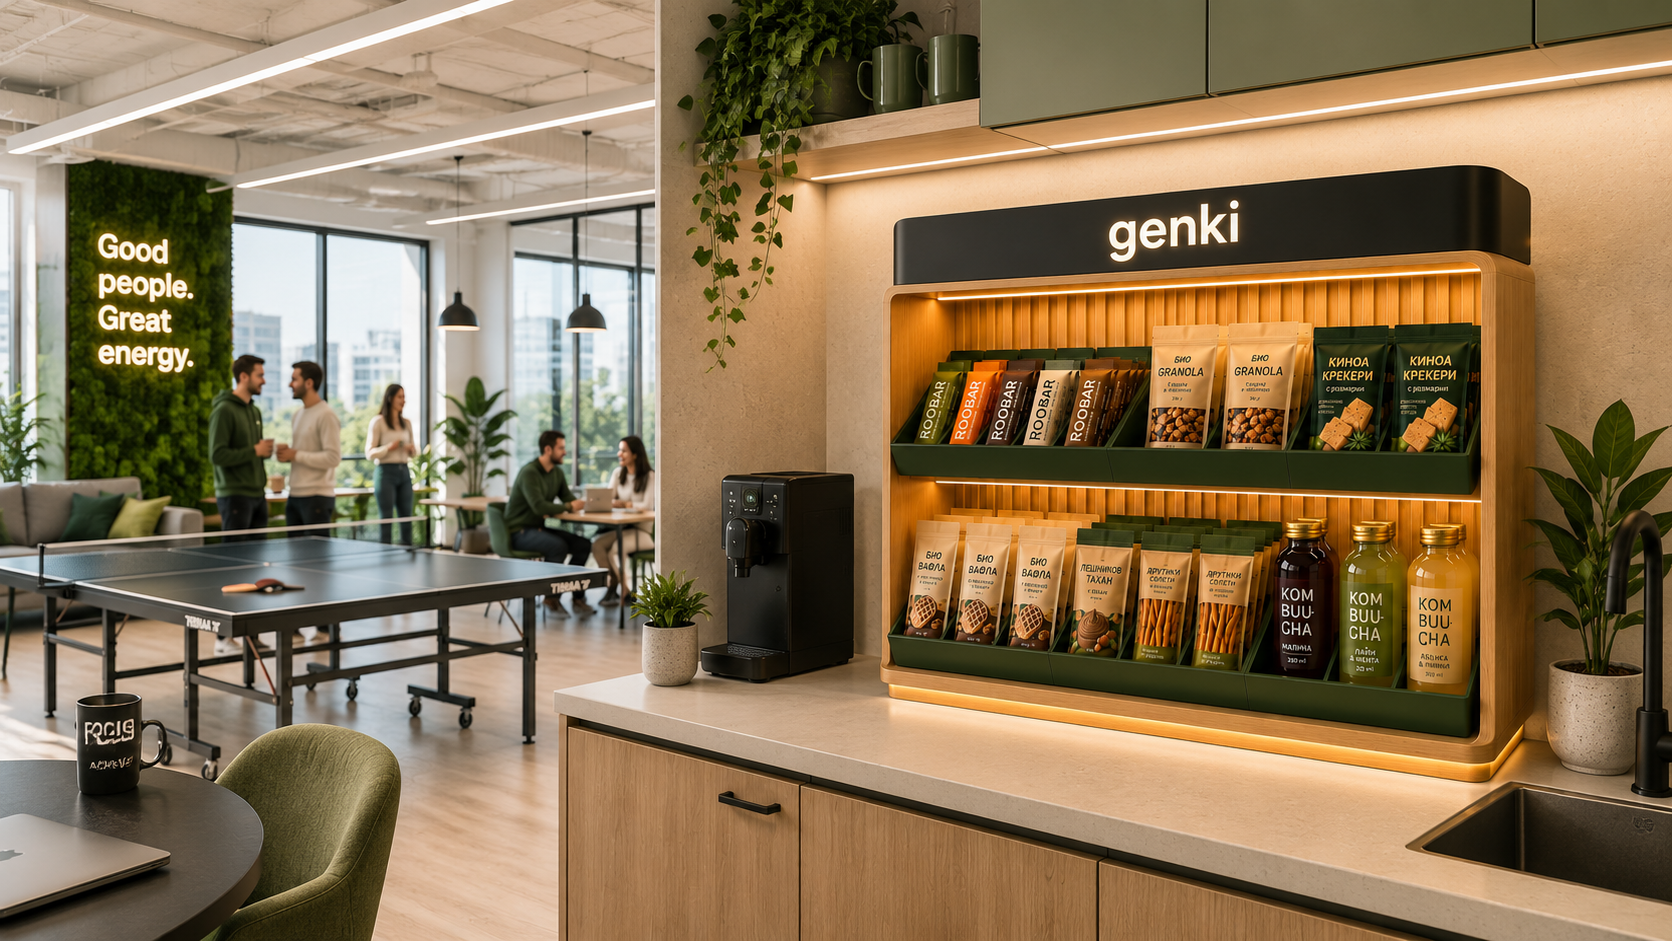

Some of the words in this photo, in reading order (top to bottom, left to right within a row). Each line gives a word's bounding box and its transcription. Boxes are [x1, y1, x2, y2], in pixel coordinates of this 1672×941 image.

[1109, 200, 1239, 262] genki
[98, 233, 168, 264] Good
[98, 273, 194, 302] people.
[98, 305, 172, 333] Great
[98, 344, 194, 373] energy.
[1328, 357, 1369, 368] КИНОА
[1409, 355, 1452, 366] КИНОА
[1158, 367, 1204, 377] GRANOLA
[1234, 366, 1283, 376] GRANOLA
[1322, 370, 1374, 381] КРЕКЕРИ
[1403, 369, 1457, 381] КРЕКЕРИ
[920, 380, 947, 439] ROOBAR
[954, 380, 983, 440] ROOBAR
[991, 379, 1018, 440] ROOBAR
[1029, 379, 1056, 441] ROOBAR
[1070, 379, 1096, 442] ROOBAR
[1281, 587, 1314, 602] KOM
[1350, 591, 1383, 606] KOM
[1418, 597, 1452, 612] KOM
[1281, 621, 1313, 636] CHA
[1349, 625, 1381, 642] CHA
[1418, 631, 1450, 647] CHA
